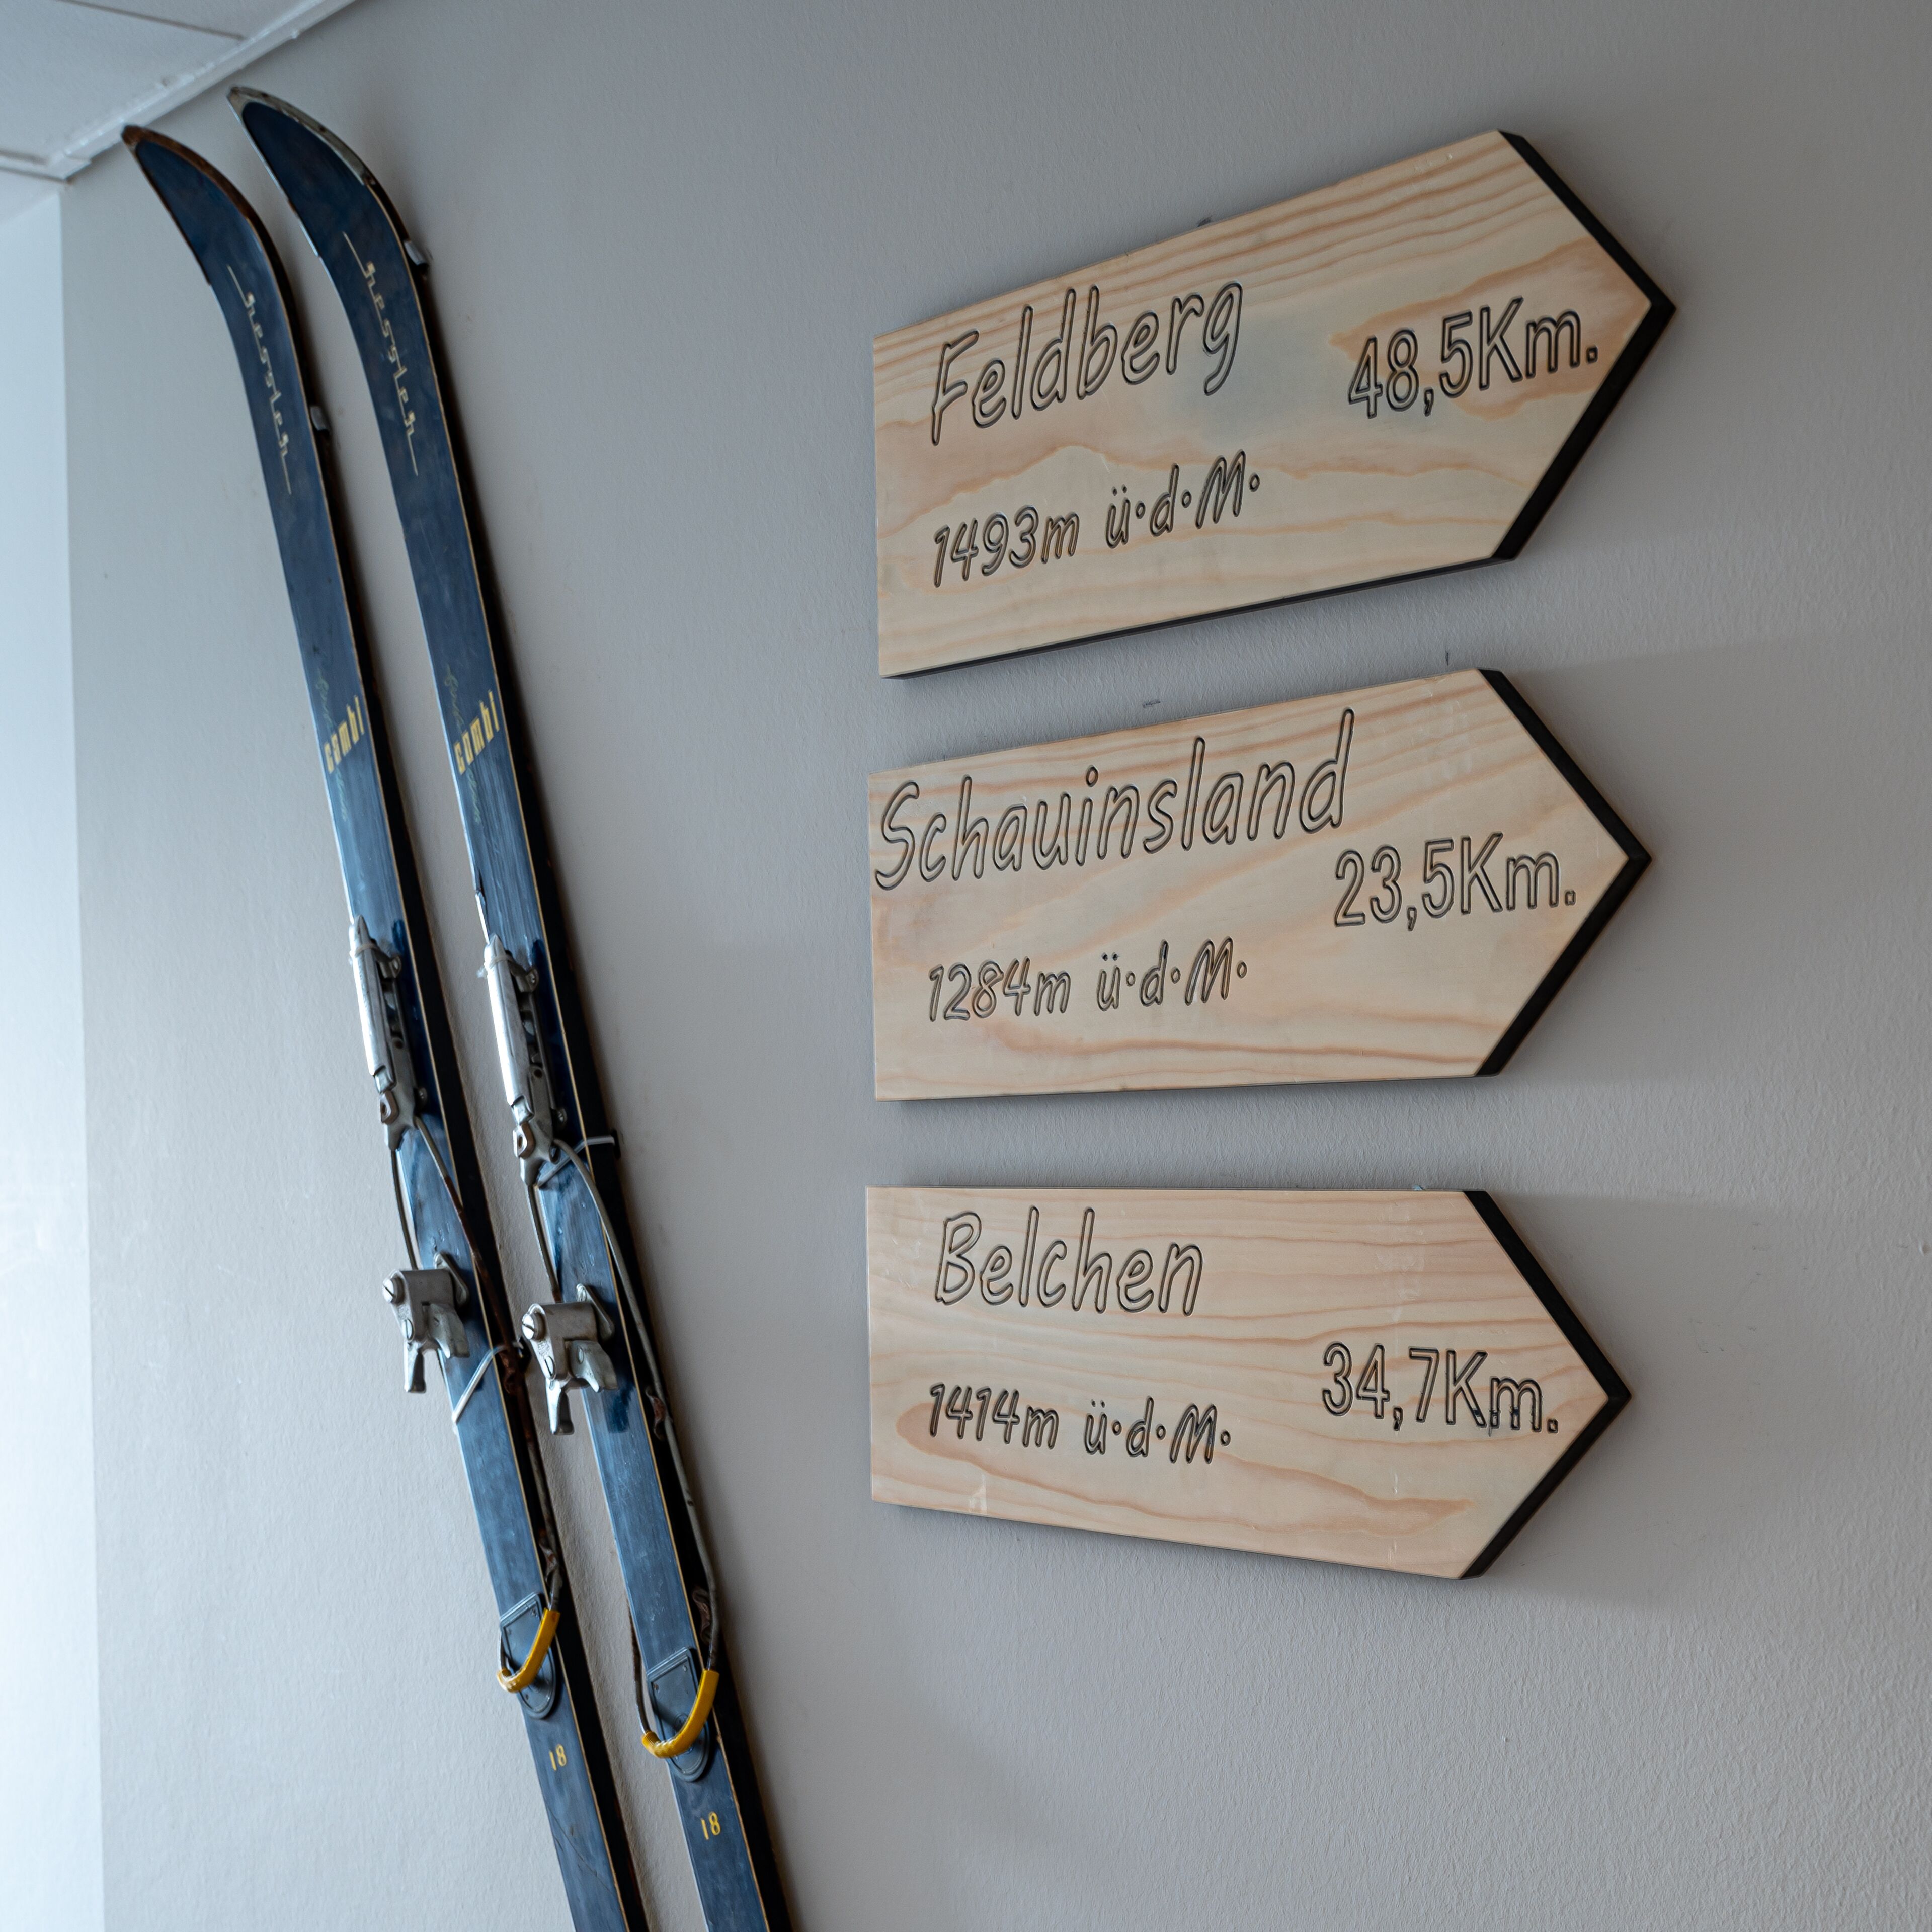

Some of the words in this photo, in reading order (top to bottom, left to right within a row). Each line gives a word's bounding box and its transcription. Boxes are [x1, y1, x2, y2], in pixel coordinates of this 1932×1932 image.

[930, 281, 1244, 447] Feldberg
[1347, 295, 1599, 420] 48,5Km.
[933, 505, 1081, 589] 1493m
[874, 707, 1355, 891] Schauinsland
[1333, 831, 1576, 931] 23,5Km.
[928, 955, 1072, 1023] 1284m
[933, 1204, 1204, 1317] Belchen
[929, 1382, 1060, 1451] 1414m
[1321, 1340, 1559, 1433] 34,7Km.
[548, 1744, 568, 1772] 18
[700, 1811, 721, 1840] 18
